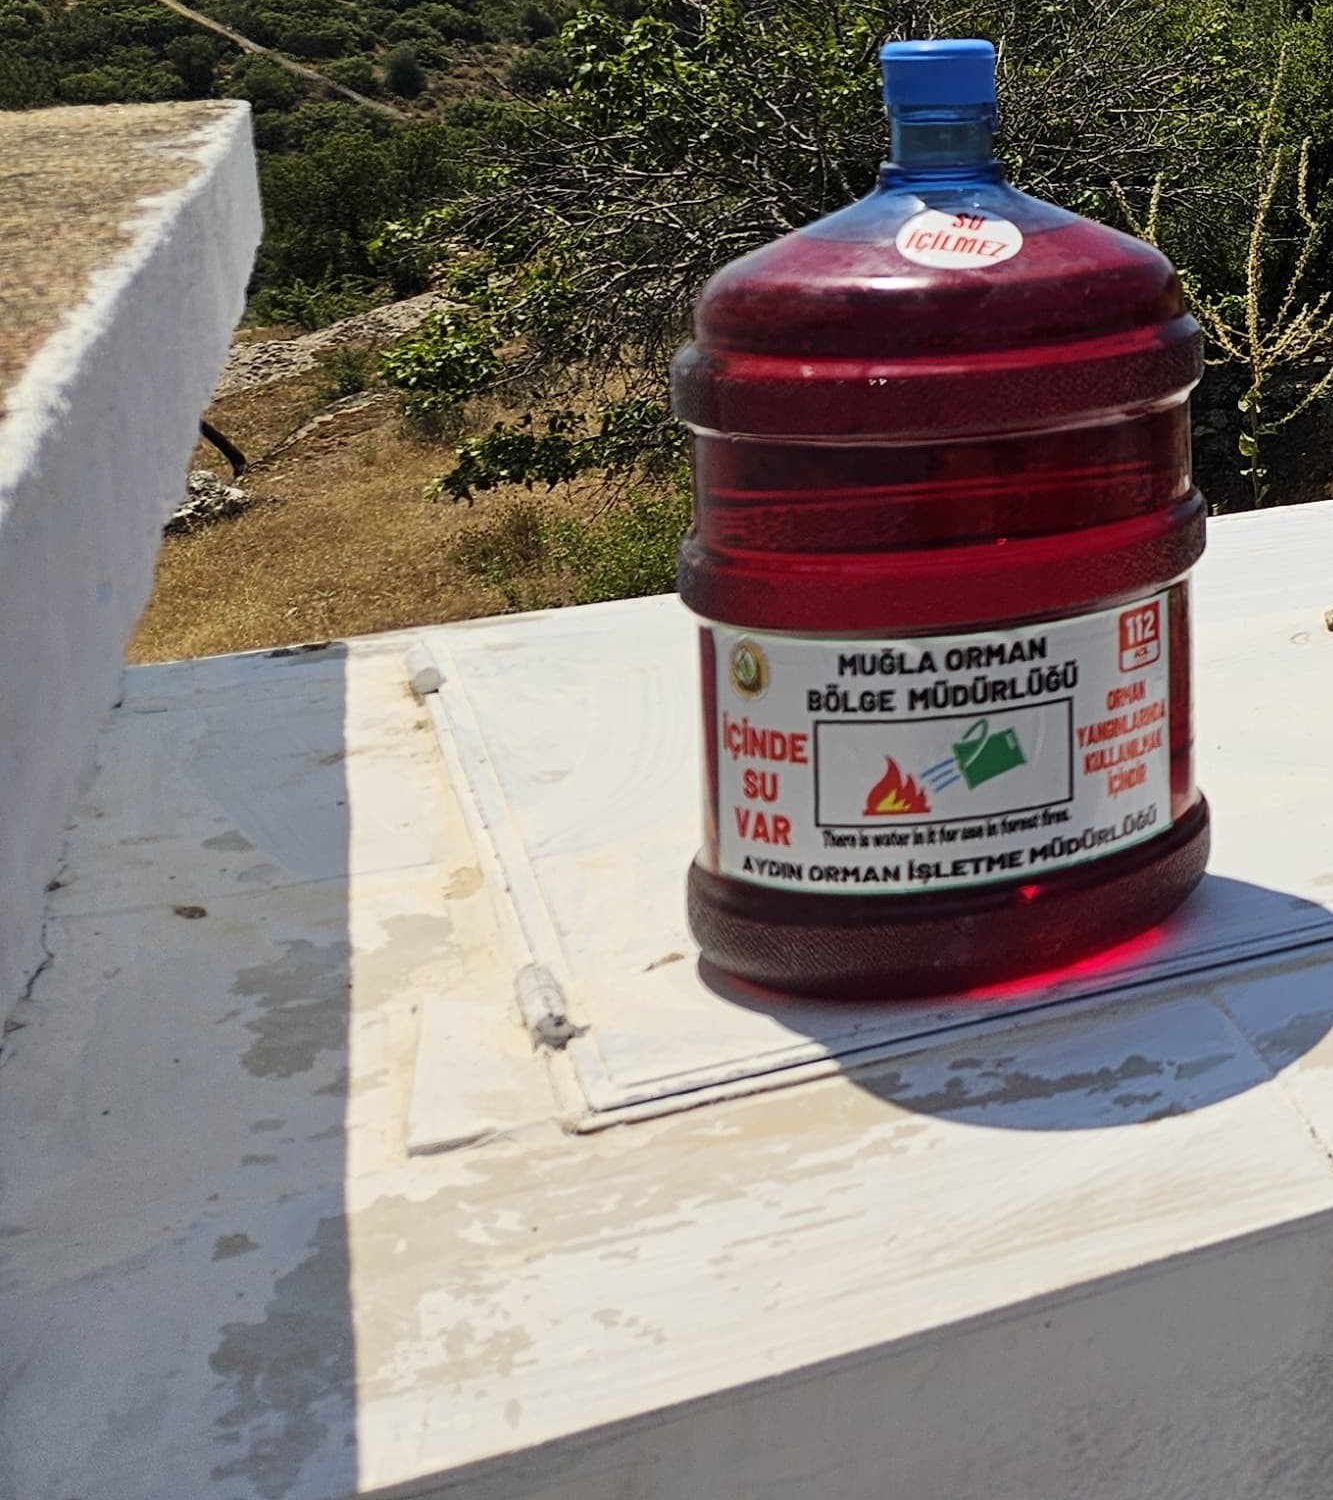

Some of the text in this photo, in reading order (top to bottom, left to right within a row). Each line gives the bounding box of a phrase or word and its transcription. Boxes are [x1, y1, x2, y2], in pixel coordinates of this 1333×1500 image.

[952, 212, 986, 231] SU
[904, 229, 1011, 257] İÇİLMEZ
[1125, 609, 1156, 646] 112
[838, 636, 1048, 676] MUĞLA ORMAN
[807, 659, 1079, 712] BÖLGE MÜDÜRLÜĞÜ
[722, 711, 809, 764] İÇİNDE
[743, 768, 778, 803] SU
[734, 805, 792, 846] VAR
[743, 804, 1158, 884] AYDIN ORMAN İŞLETME MÜDÜRLÜĞÜ
[823, 829, 857, 849] There
[858, 829, 870, 848] is
[873, 829, 908, 847] water
[913, 825, 926, 845] in
[927, 824, 937, 845] it
[939, 823, 957, 843] for
[960, 826, 984, 841] use
[987, 820, 999, 838] in
[1001, 814, 1039, 836] forest
